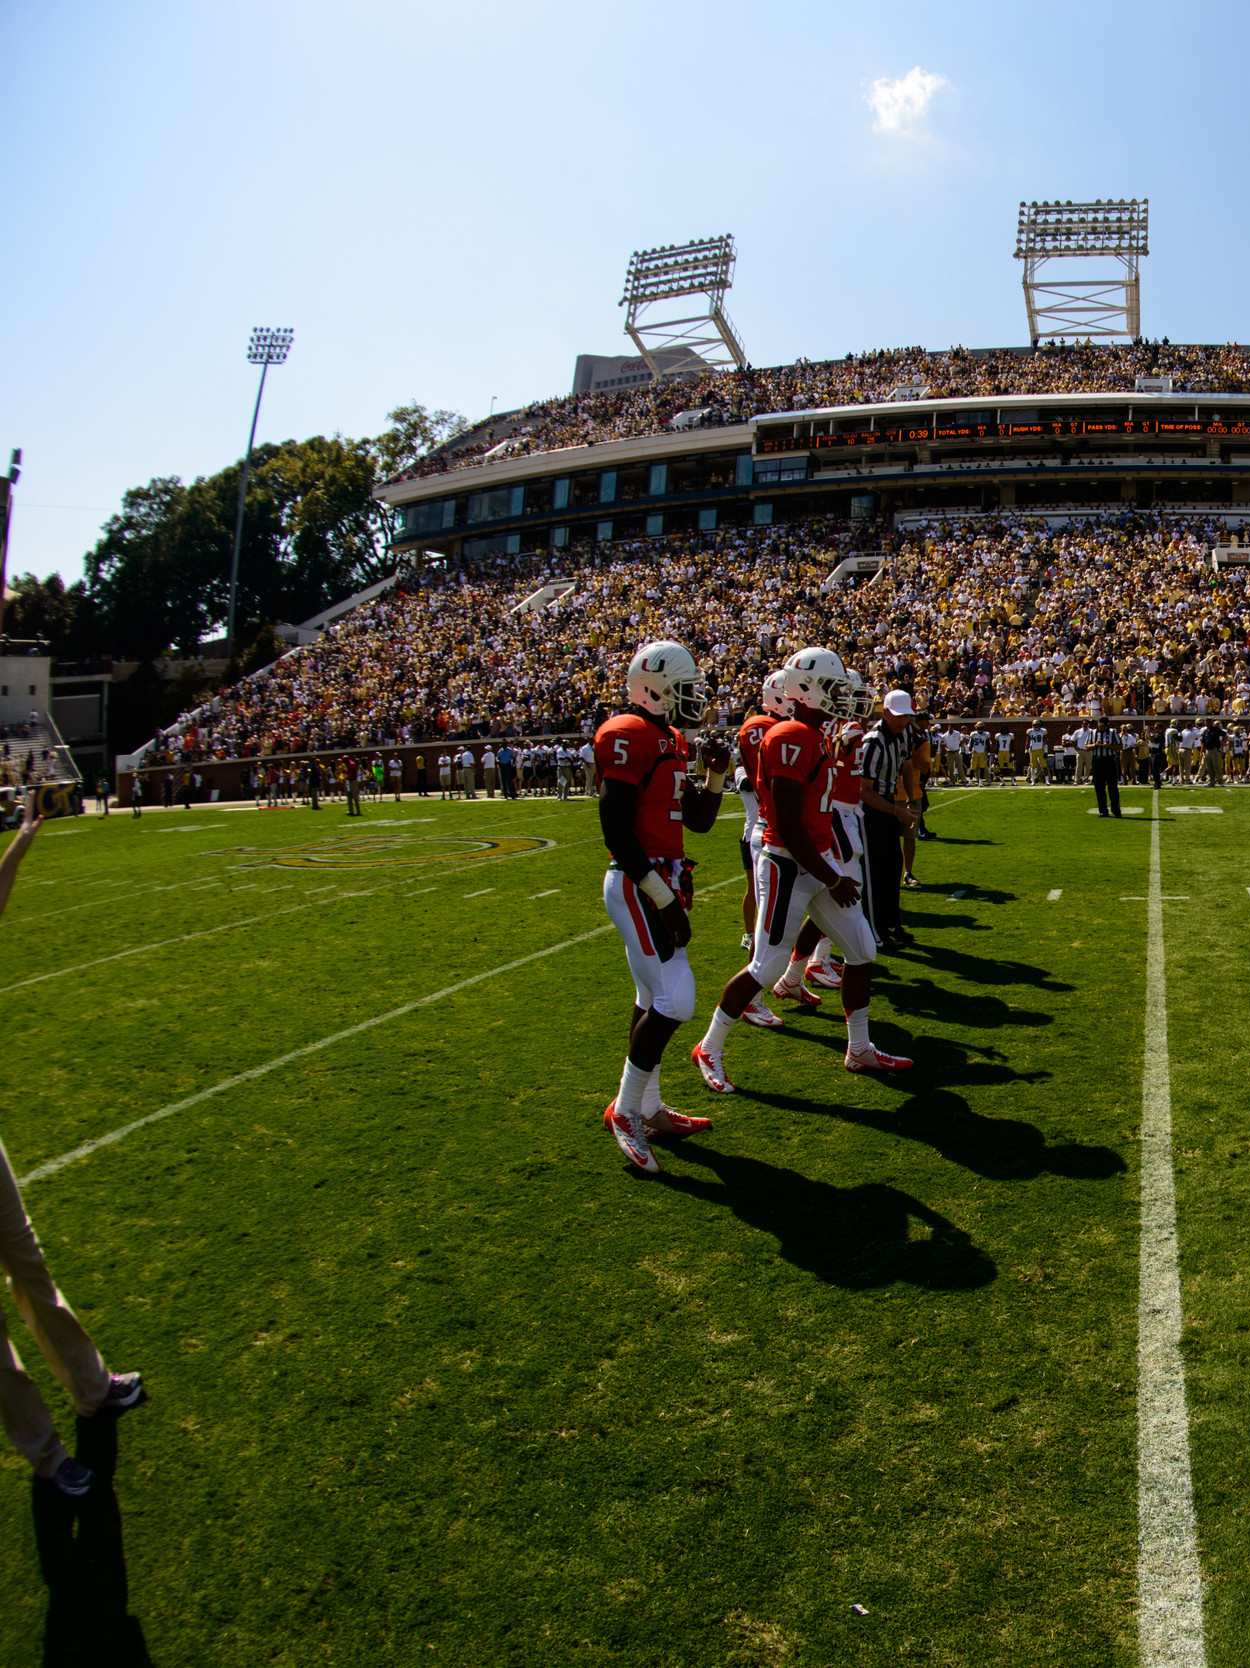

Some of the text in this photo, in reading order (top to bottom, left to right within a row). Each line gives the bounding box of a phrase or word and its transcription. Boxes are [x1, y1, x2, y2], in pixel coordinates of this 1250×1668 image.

[909, 430, 929, 439] 0:39
[999, 428, 1005, 436] 0
[1071, 426, 1077, 434] 0
[1207, 426, 1228, 434] 00:00
[641, 658, 666, 672] U
[794, 658, 816, 671] U
[747, 727, 764, 746] 21
[614, 738, 630, 765] 5
[781, 743, 802, 767] 17
[37, 783, 76, 818] GT
[669, 770, 686, 821] 5
